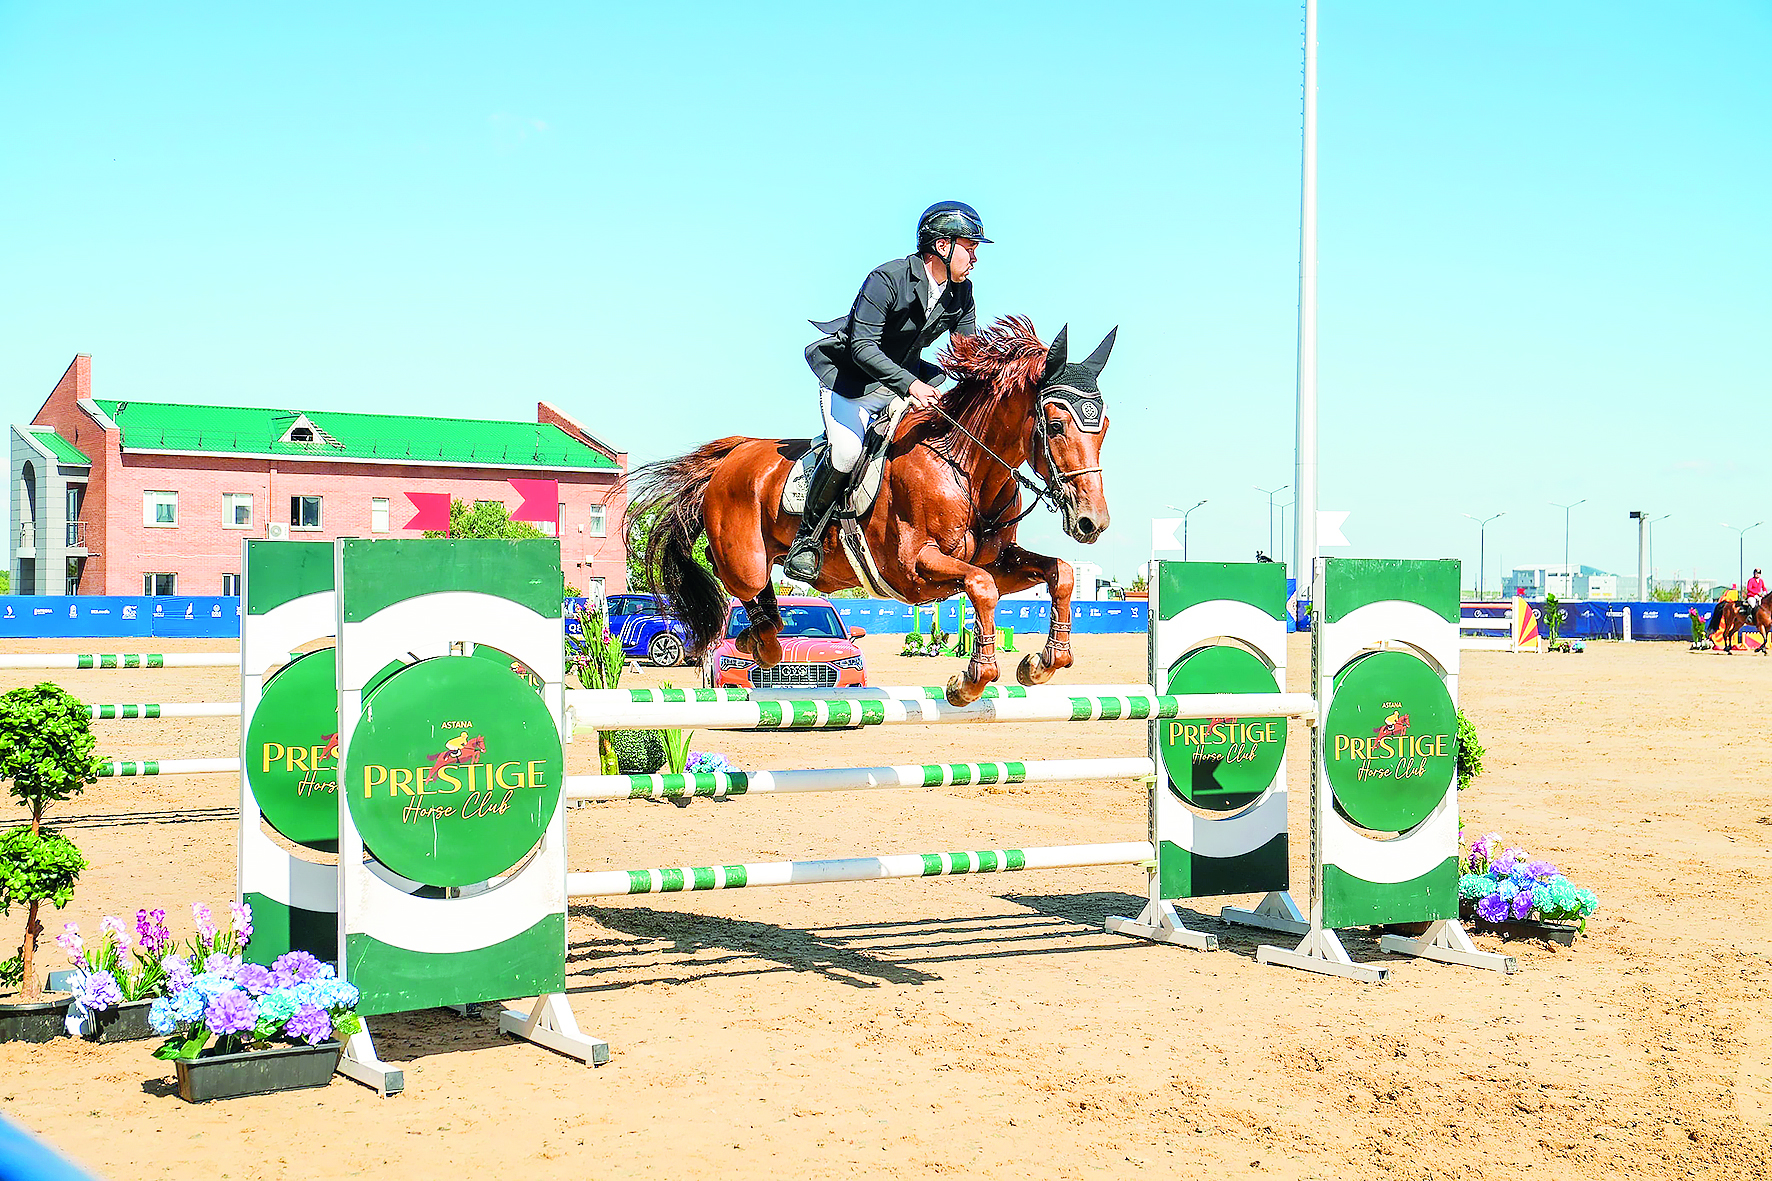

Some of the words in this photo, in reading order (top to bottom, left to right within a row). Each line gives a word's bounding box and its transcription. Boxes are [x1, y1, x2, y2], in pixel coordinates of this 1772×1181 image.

[441, 721, 473, 730] ASTANA
[1168, 722, 1278, 746] PRESTIGE
[1192, 745, 1224, 765] Horse
[1226, 743, 1258, 763] Club
[1335, 734, 1449, 760] PRESTIGE
[364, 760, 548, 798] PRESTIGE
[1358, 760, 1392, 781] Horse
[1395, 757, 1427, 780] Club
[298, 771, 338, 797] Hors
[403, 795, 457, 824] Horse
[461, 790, 511, 819] Club
